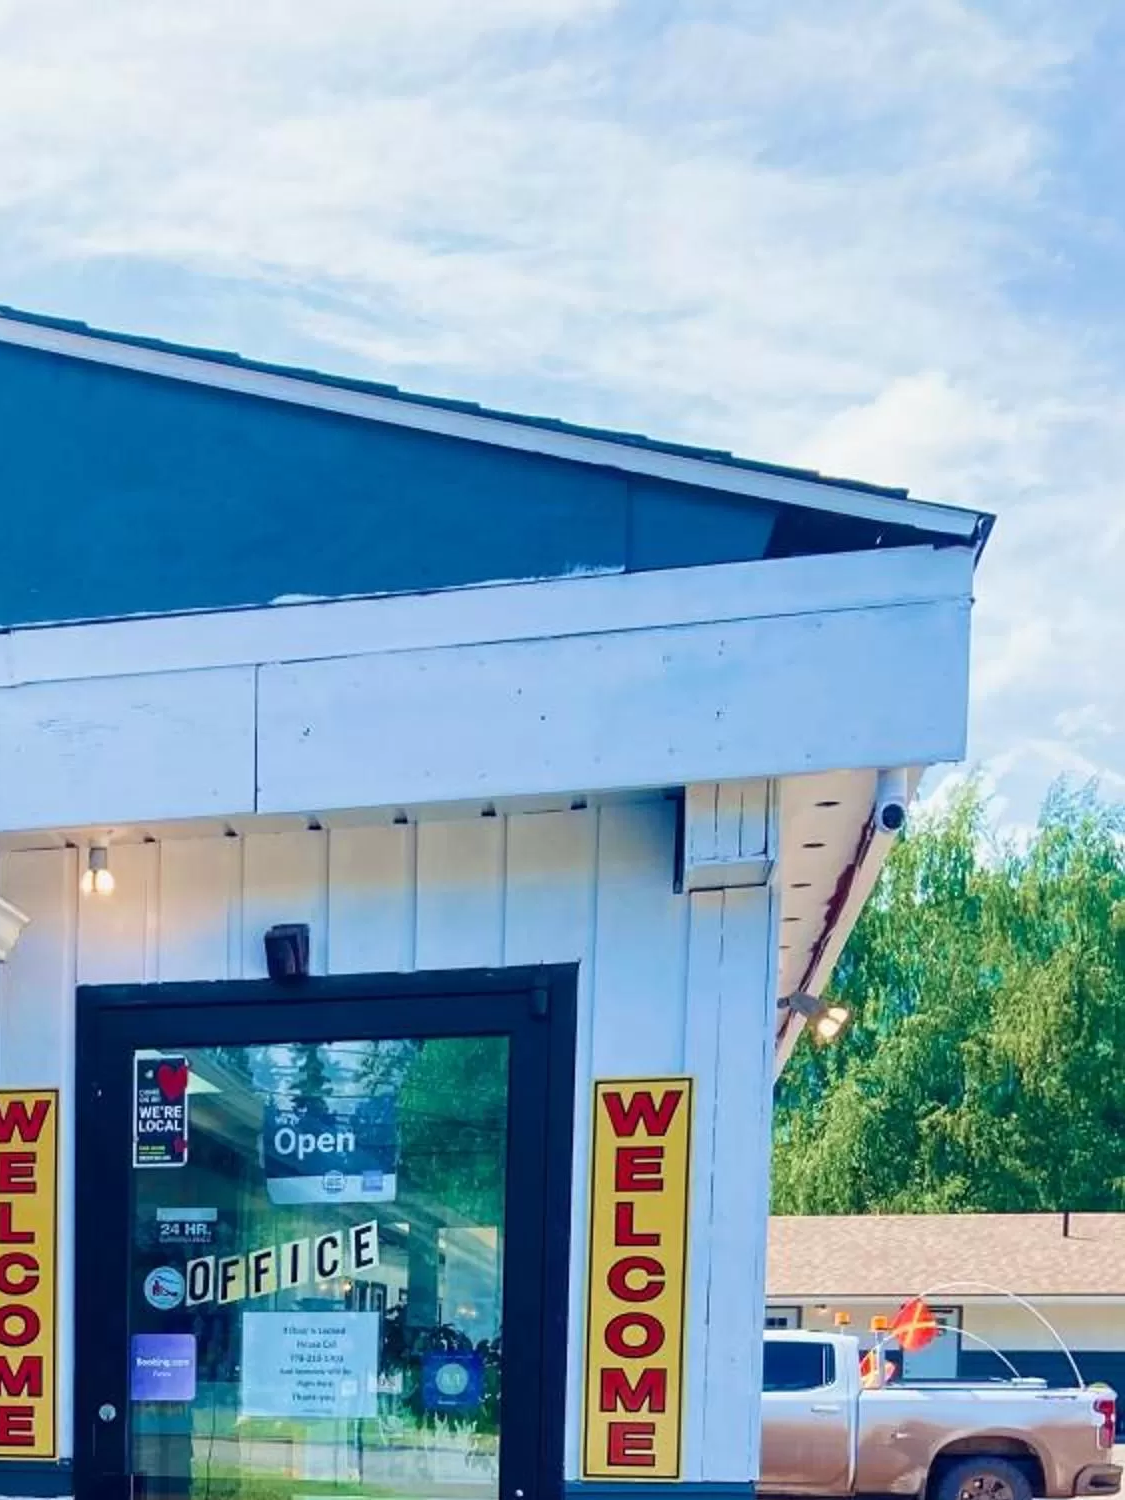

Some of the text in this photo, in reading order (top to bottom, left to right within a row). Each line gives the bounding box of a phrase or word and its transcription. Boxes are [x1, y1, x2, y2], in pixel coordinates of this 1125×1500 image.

[138, 1105, 183, 1119] WE'RE
[138, 1119, 182, 1133] LOCAL
[274, 1127, 355, 1160] Open
[160, 1223, 180, 1236] 24
[188, 1225, 373, 1301] OFFICE
[599, 1090, 683, 1467] WELCOME
